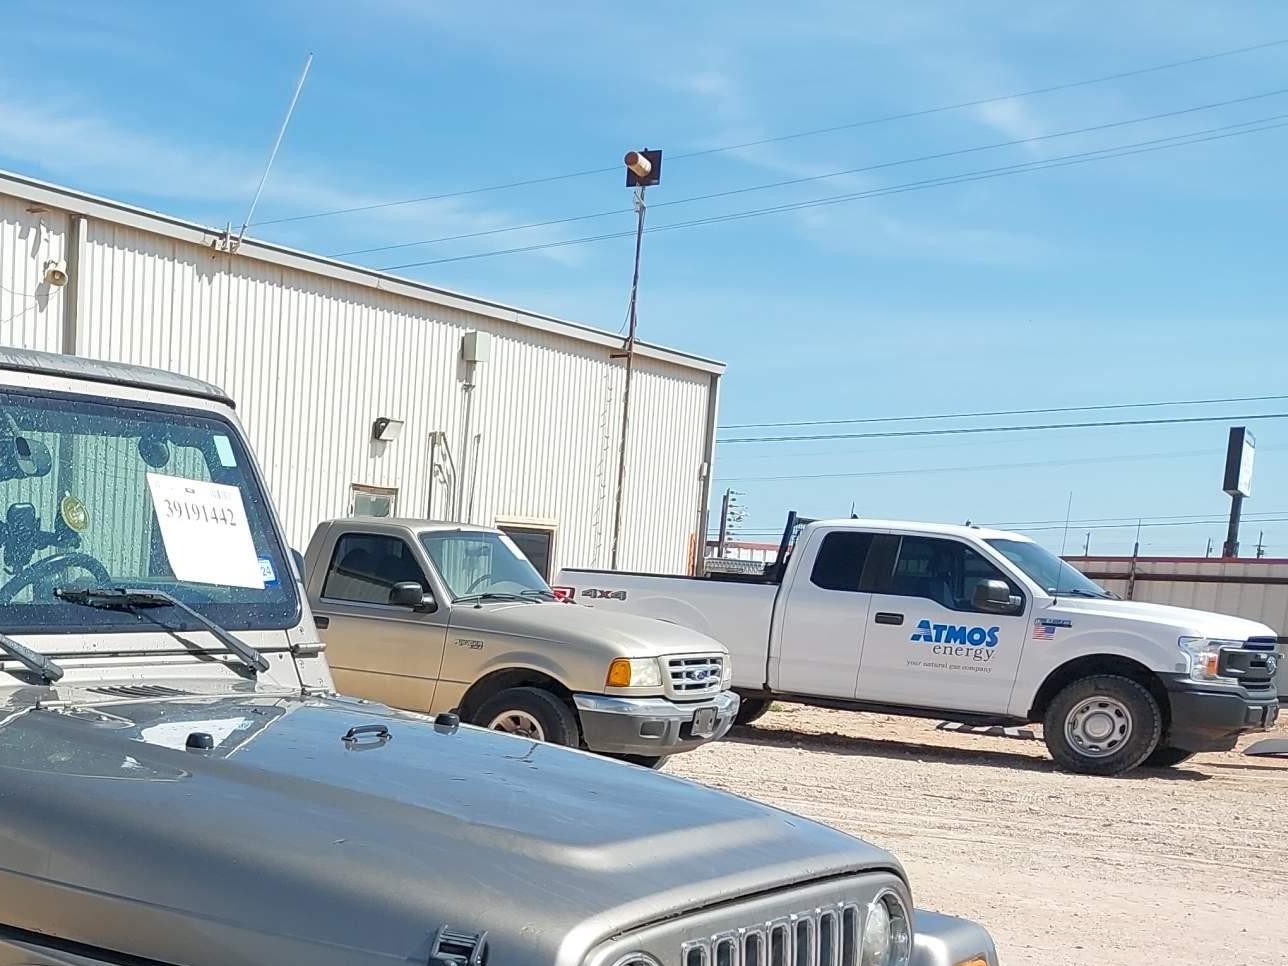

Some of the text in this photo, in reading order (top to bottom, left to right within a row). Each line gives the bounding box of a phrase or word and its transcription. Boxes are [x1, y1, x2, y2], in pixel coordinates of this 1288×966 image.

[164, 499, 237, 526] 39191442
[911, 620, 999, 647] ATMOS
[933, 644, 995, 662] energy
